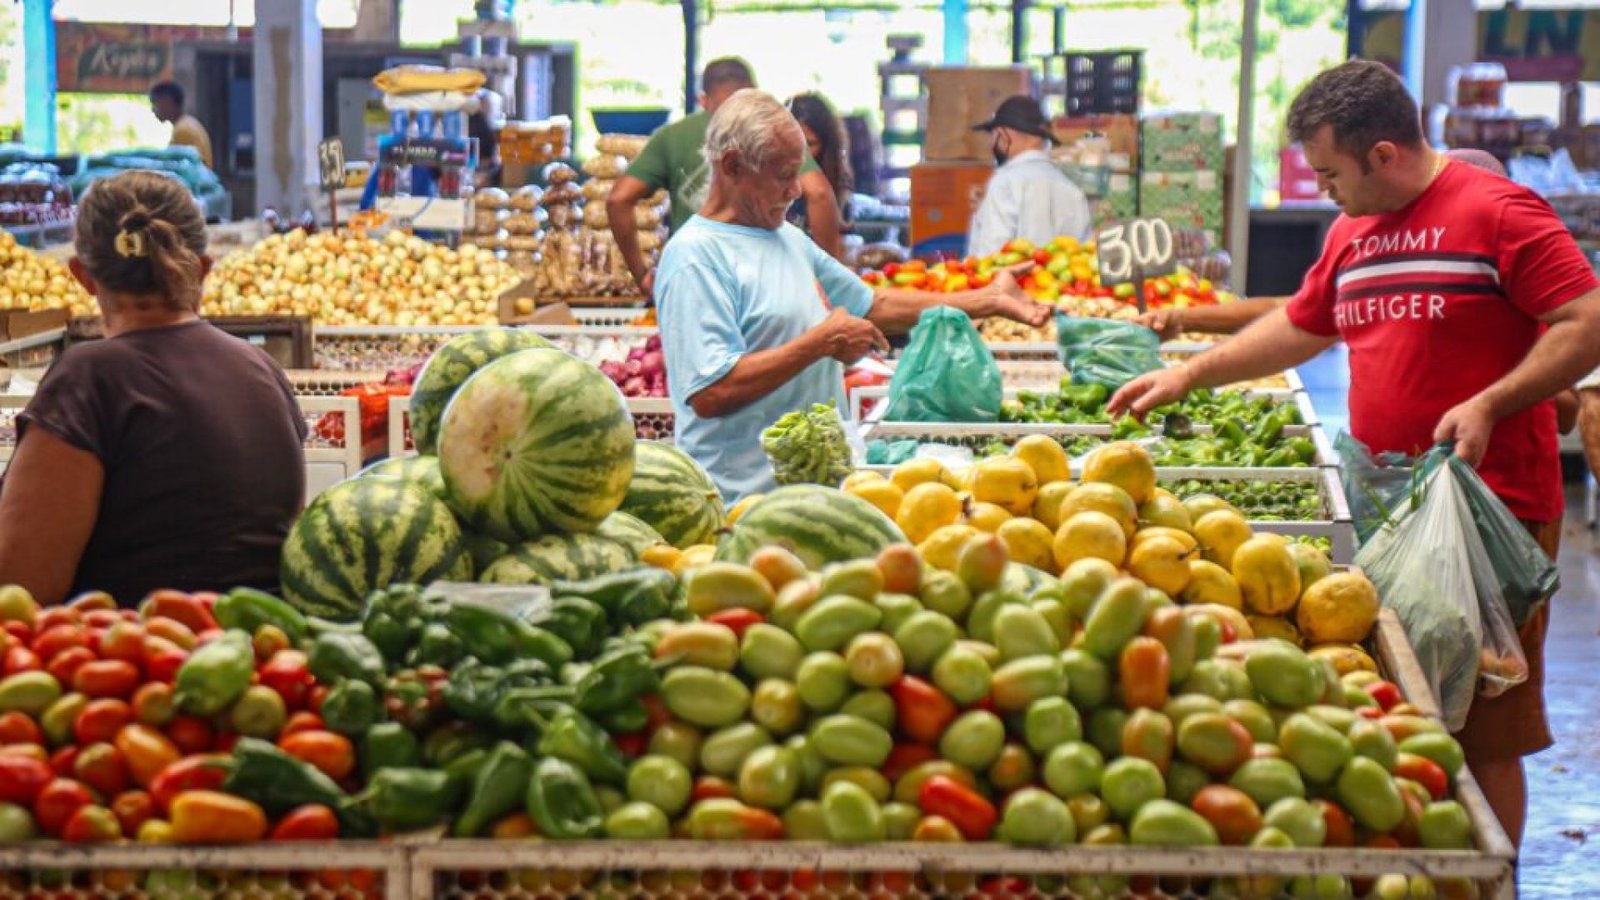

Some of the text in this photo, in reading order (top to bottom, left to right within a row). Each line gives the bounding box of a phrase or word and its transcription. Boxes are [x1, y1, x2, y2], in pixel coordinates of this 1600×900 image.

[1099, 218, 1172, 278] 3,00
[1351, 226, 1446, 262] TOMMY
[1334, 294, 1446, 327] HILFIGER
